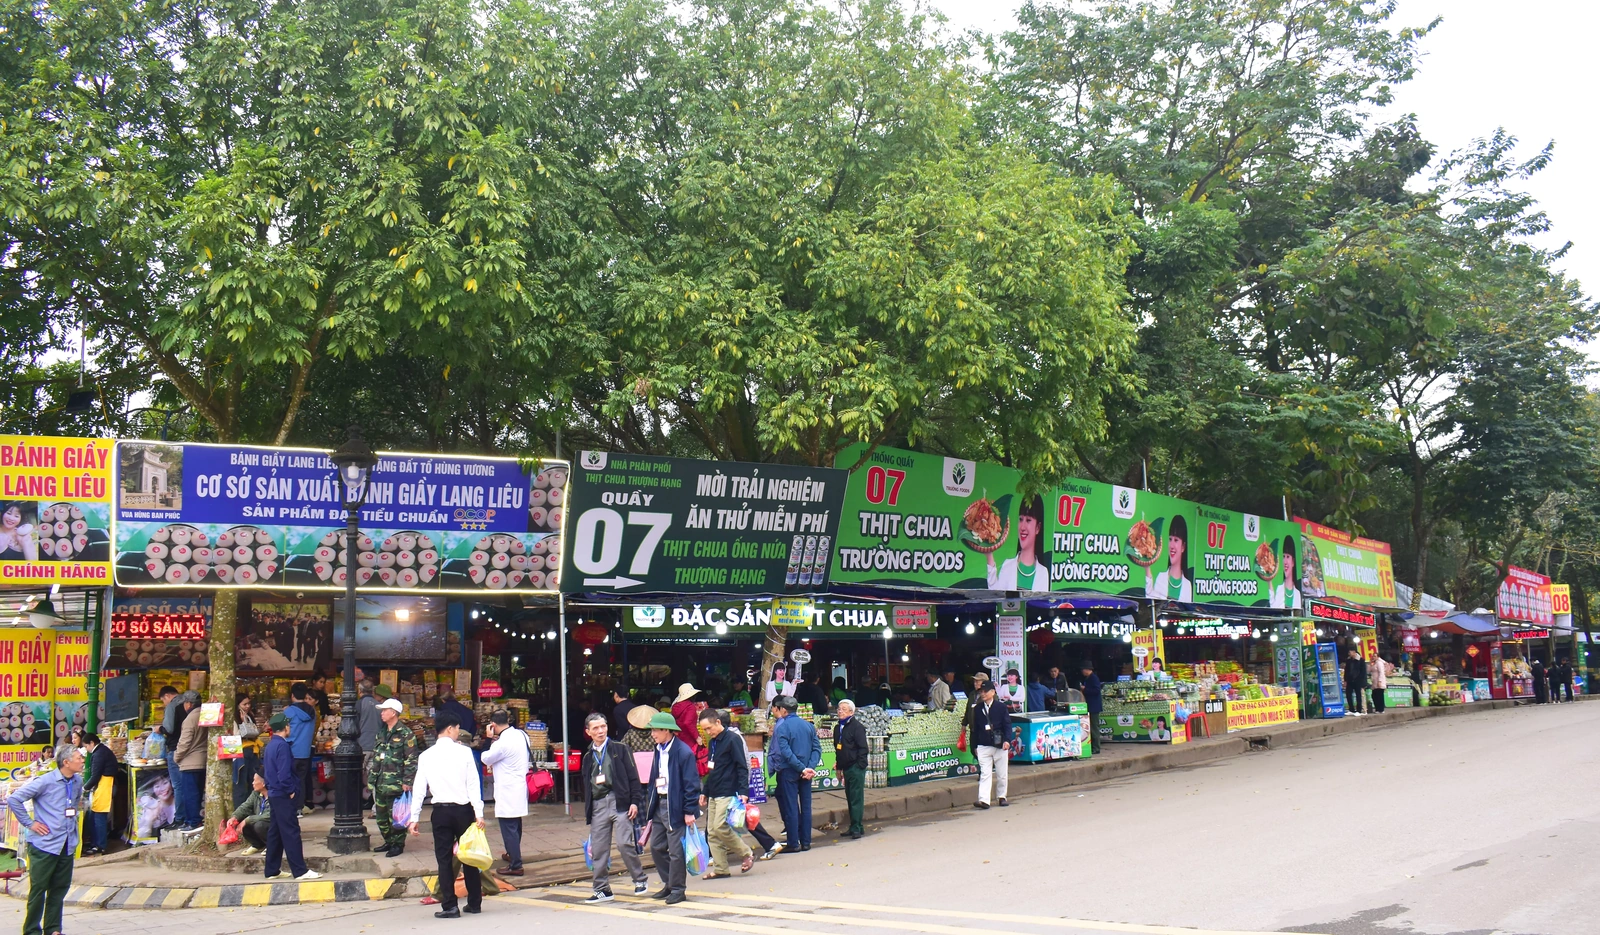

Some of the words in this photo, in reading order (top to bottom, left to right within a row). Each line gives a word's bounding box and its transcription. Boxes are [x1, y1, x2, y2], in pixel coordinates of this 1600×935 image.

[1, 441, 56, 468] BÁNH
[230, 452, 259, 466] BÁNH
[288, 456, 314, 469] LANG
[372, 458, 397, 474] ẶNG
[399, 458, 417, 473] ĐẤT
[434, 461, 461, 475] HÙNG
[463, 463, 495, 477] VƯƠNG
[610, 459, 628, 470] NHÀ
[629, 460, 651, 472] PHÂN
[4, 475, 57, 497] LANG
[64, 473, 106, 498] LIÊU
[196, 474, 222, 498] CƠ
[226, 467, 251, 499] SỞ
[255, 468, 292, 500] SẢN
[297, 472, 340, 502] XUẤT
[441, 484, 484, 508] LANG
[488, 483, 523, 509] LIÊU
[585, 473, 603, 485] THỊT
[604, 474, 626, 485] CHUA
[628, 476, 659, 488] THƯỢNG
[660, 478, 682, 489] HẠNG
[696, 468, 728, 498] MỜI
[731, 468, 765, 499] TRẢI
[767, 476, 825, 506] NGHIỆM
[865, 465, 907, 507] 07
[134, 511, 150, 519] HÙNG
[164, 511, 181, 519] PHÚC
[242, 502, 275, 518] SẢN
[279, 504, 325, 520] PHẨM
[329, 509, 359, 522] ĐẠ
[453, 509, 496, 520] OCOP
[685, 503, 712, 529] ĂN
[717, 502, 752, 531] THỬ
[752, 504, 797, 532] MIỄN
[799, 510, 829, 533] PHÍ
[1057, 494, 1087, 527] 07
[859, 512, 902, 543] THỊT
[904, 517, 952, 538] CHUA
[1207, 521, 1227, 549] 07
[573, 507, 673, 575] 07
[663, 540, 691, 561] THỊT
[693, 540, 728, 558] CHUA
[732, 536, 760, 559] ỐNG
[1053, 533, 1083, 557] THỊT
[1085, 534, 1120, 553] CHUA
[839, 544, 911, 570] TRƯỜNG
[913, 552, 964, 571] FOODS
[1204, 554, 1226, 575] THỊT
[1226, 555, 1250, 571] CHUA
[1323, 552, 1339, 578] BẢO
[3, 562, 55, 578] CHÍNH
[60, 563, 106, 579] HÃNG
[674, 566, 728, 588] THƯỢNG
[729, 569, 767, 588] HẠNG
[1091, 564, 1129, 581] FOODS
[1195, 575, 1231, 595] TRƯỜNG
[1231, 581, 1257, 595] FOODS
[1379, 570, 1394, 598] 15
[1553, 594, 1569, 612] 08
[130, 616, 150, 634] SỞ
[153, 616, 183, 634] SẢN
[671, 604, 720, 630] ĐẶC
[725, 602, 772, 626] SẢN
[829, 609, 888, 626] CHUA
[1111, 623, 1136, 636] CHU
[17, 668, 49, 697] LIÊU
[1279, 710, 1283, 720] 5
[30, 752, 42, 762] CHU
[911, 750, 928, 762] THỊT
[930, 747, 952, 757] CHUA
[904, 761, 935, 774] TRƯỜNG
[936, 759, 959, 769] FOODS
